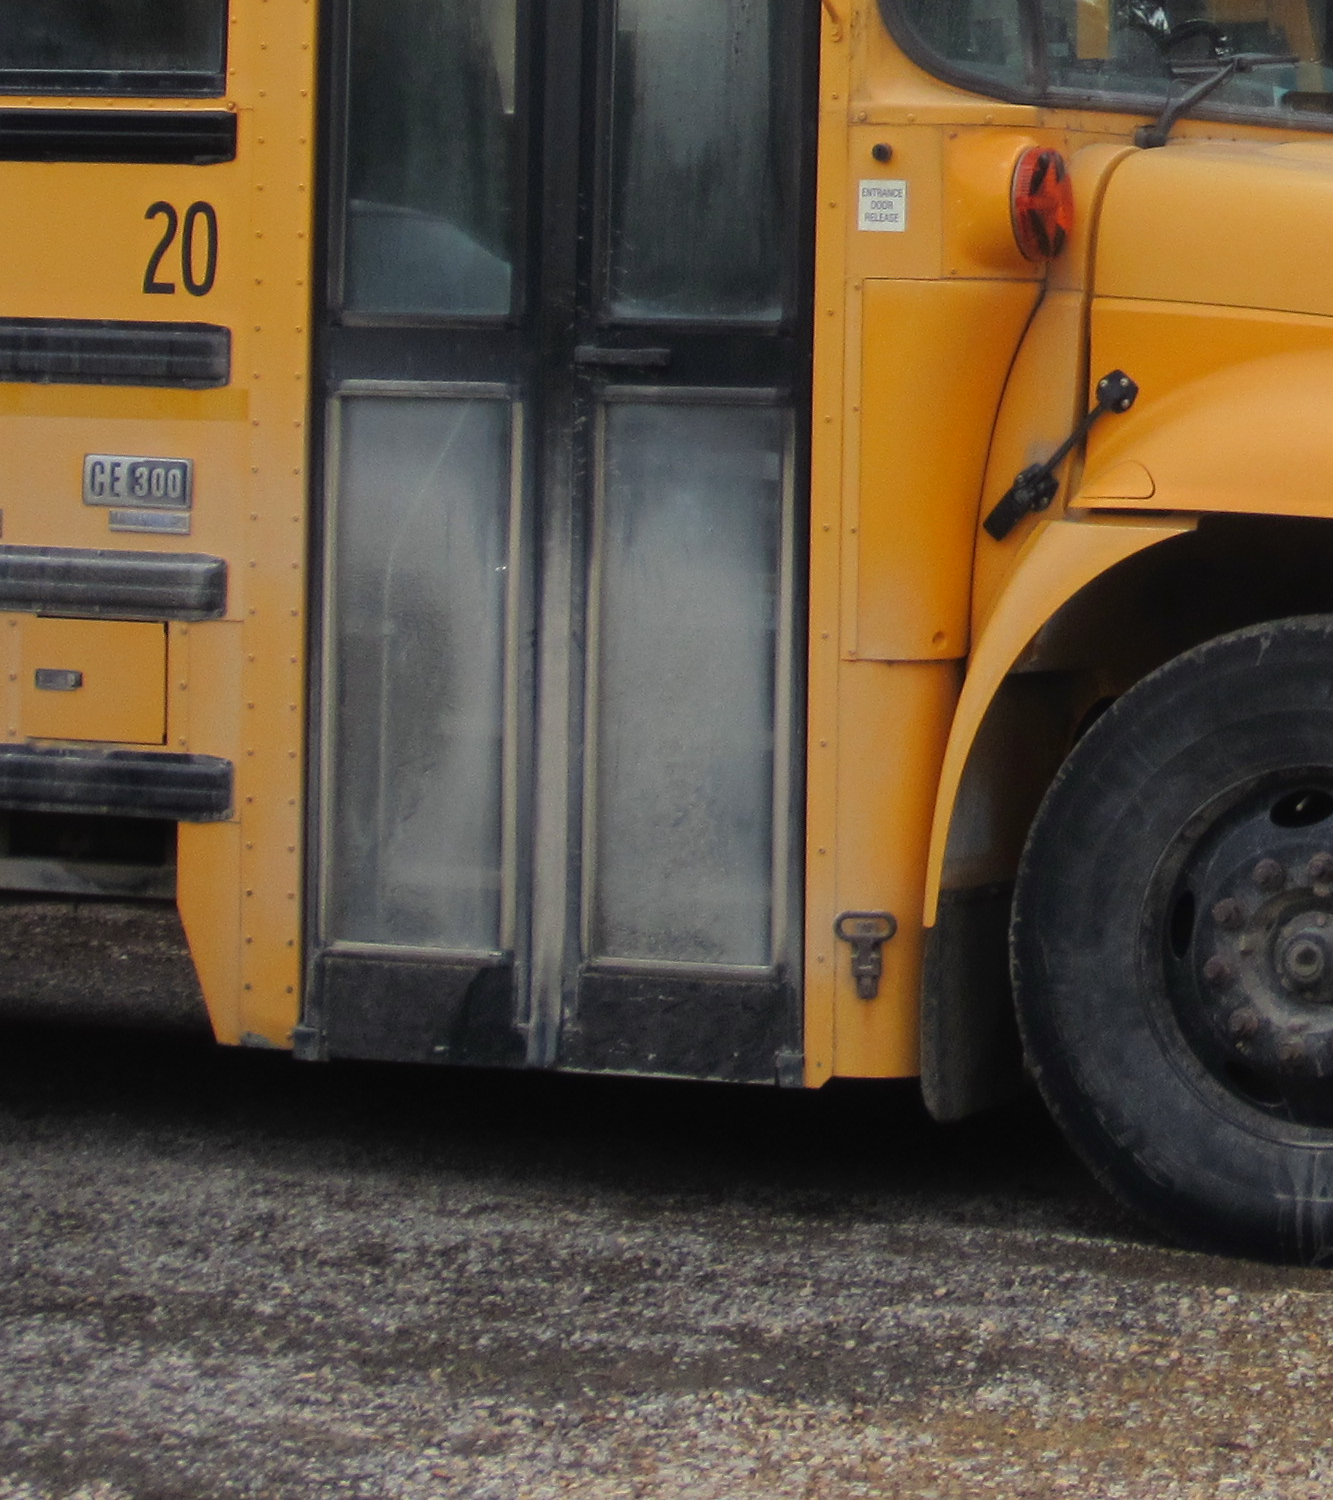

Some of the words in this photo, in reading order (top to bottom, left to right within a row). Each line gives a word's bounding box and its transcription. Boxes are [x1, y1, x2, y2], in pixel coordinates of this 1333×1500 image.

[861, 187, 903, 198] ENTRANCE
[870, 200, 894, 210] DOOR
[863, 212, 899, 223] RELEASE
[142, 200, 219, 297] 20
[90, 460, 122, 498] CE
[133, 466, 183, 499] 300
